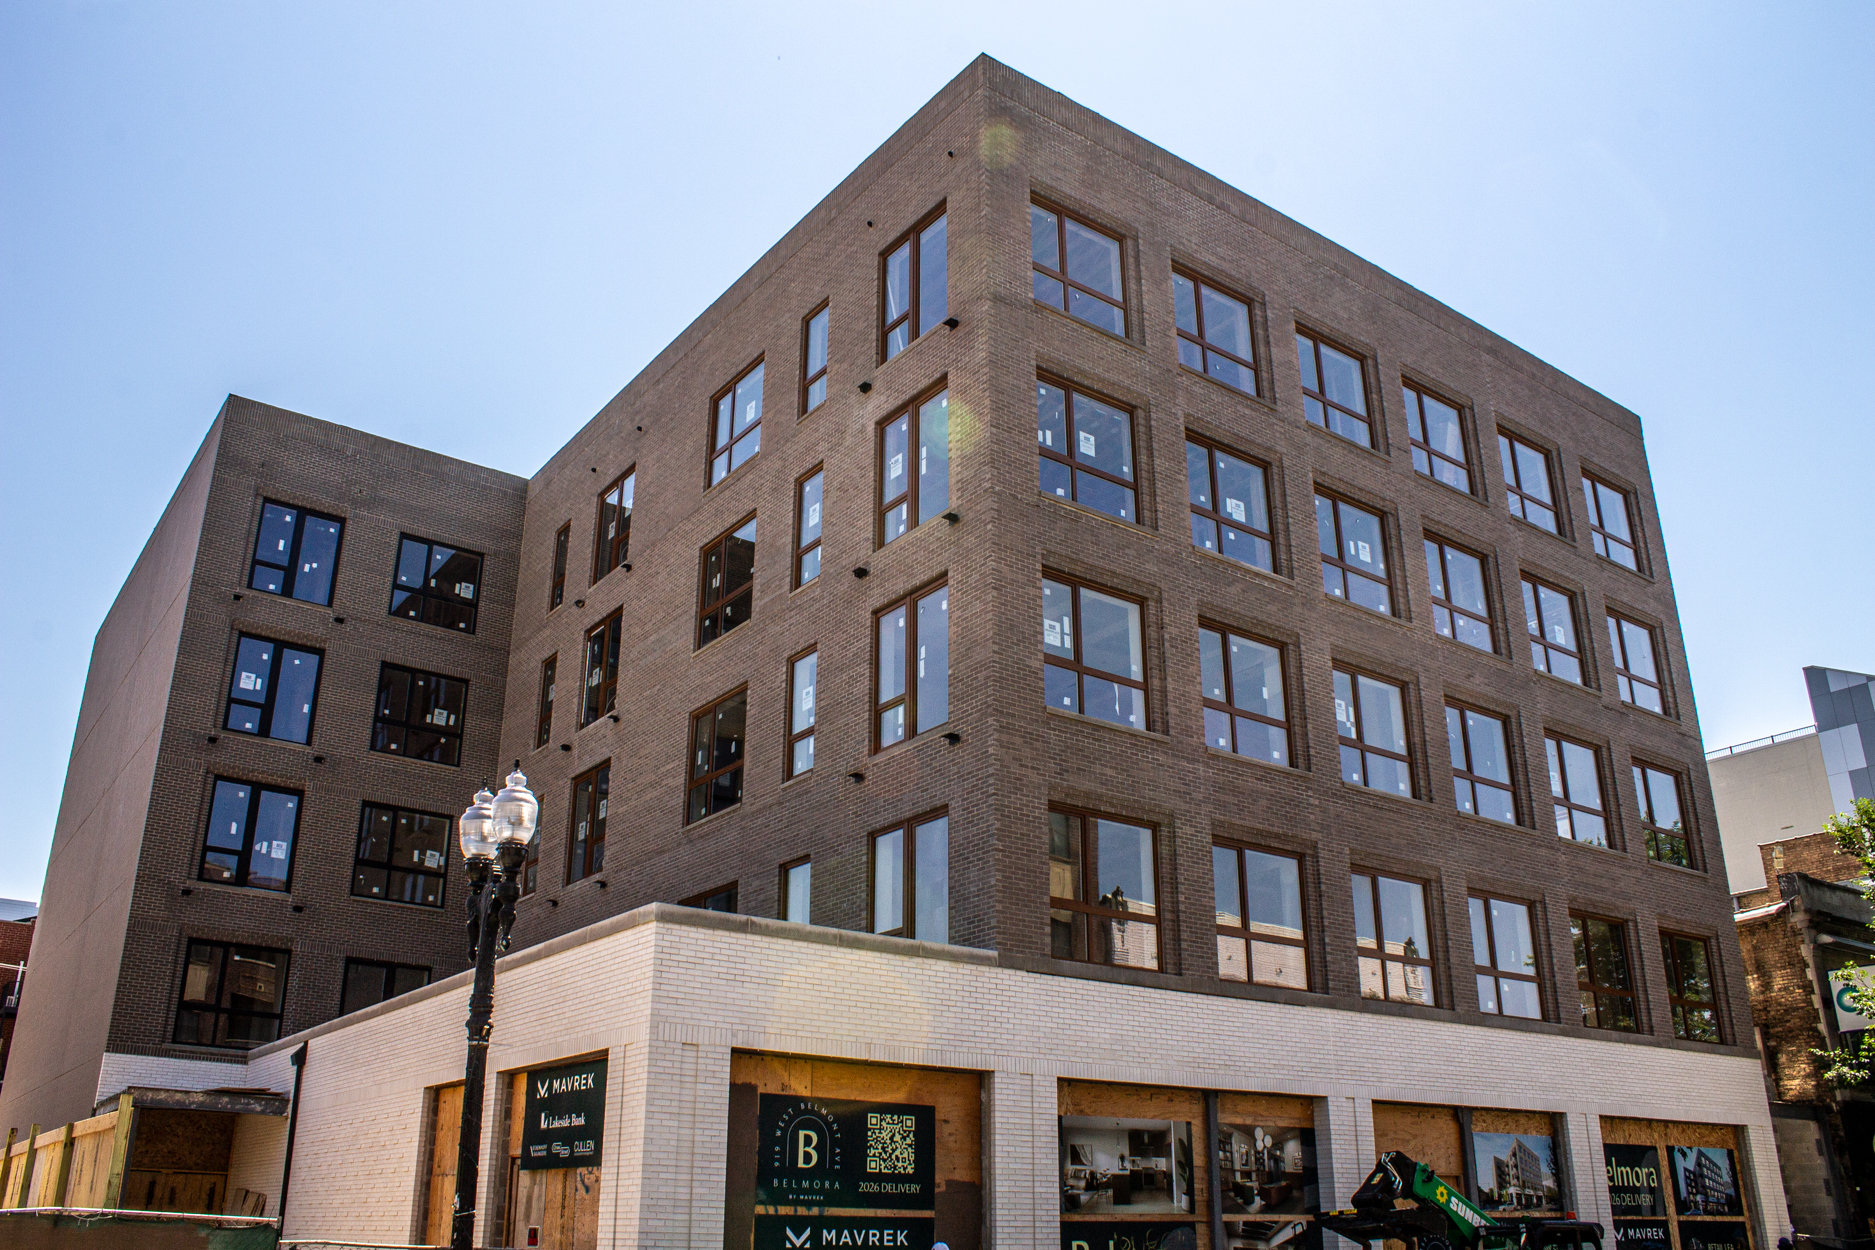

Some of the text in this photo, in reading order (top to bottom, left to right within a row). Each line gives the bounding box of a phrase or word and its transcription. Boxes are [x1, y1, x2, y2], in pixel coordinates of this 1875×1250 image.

[552, 1072, 595, 1094] MAVREK
[548, 1114, 571, 1129] Lakeside
[571, 1111, 586, 1127] Bank
[775, 1107, 794, 1137] WEST
[800, 1101, 841, 1138] BELMONT
[573, 1140, 595, 1152] CULLEN
[797, 1129, 818, 1169] B
[773, 1178, 840, 1190] BELMORA
[858, 1181, 921, 1194] 2026 DELIVERY
[1620, 1193, 1654, 1206] DELIVERY
[822, 1228, 909, 1246] MAVREK
[1627, 1227, 1666, 1240] MAVREK
